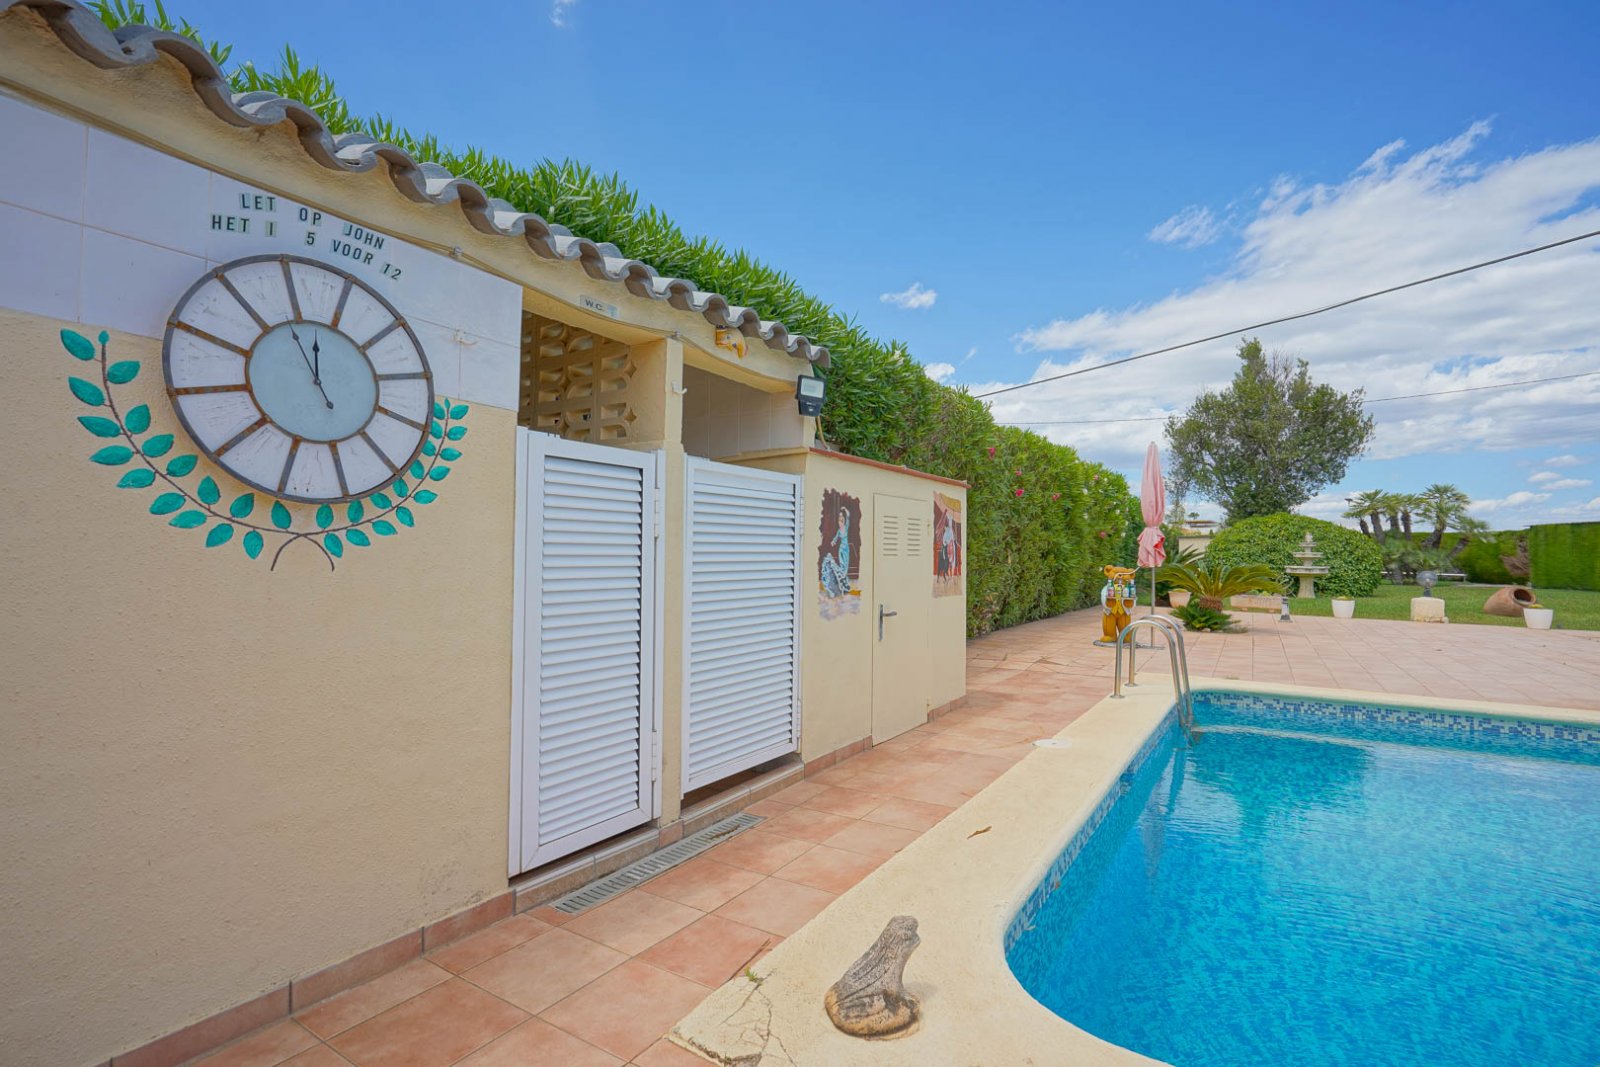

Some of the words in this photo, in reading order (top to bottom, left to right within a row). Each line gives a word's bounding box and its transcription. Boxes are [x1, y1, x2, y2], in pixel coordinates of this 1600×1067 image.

[211, 214, 250, 233] HET
[305, 231, 316, 246] 5
[332, 239, 374, 265] VOOR
[382, 262, 402, 281] 12
[241, 193, 276, 211] LET
[299, 207, 322, 226] OP
[344, 224, 385, 250] JOHN
